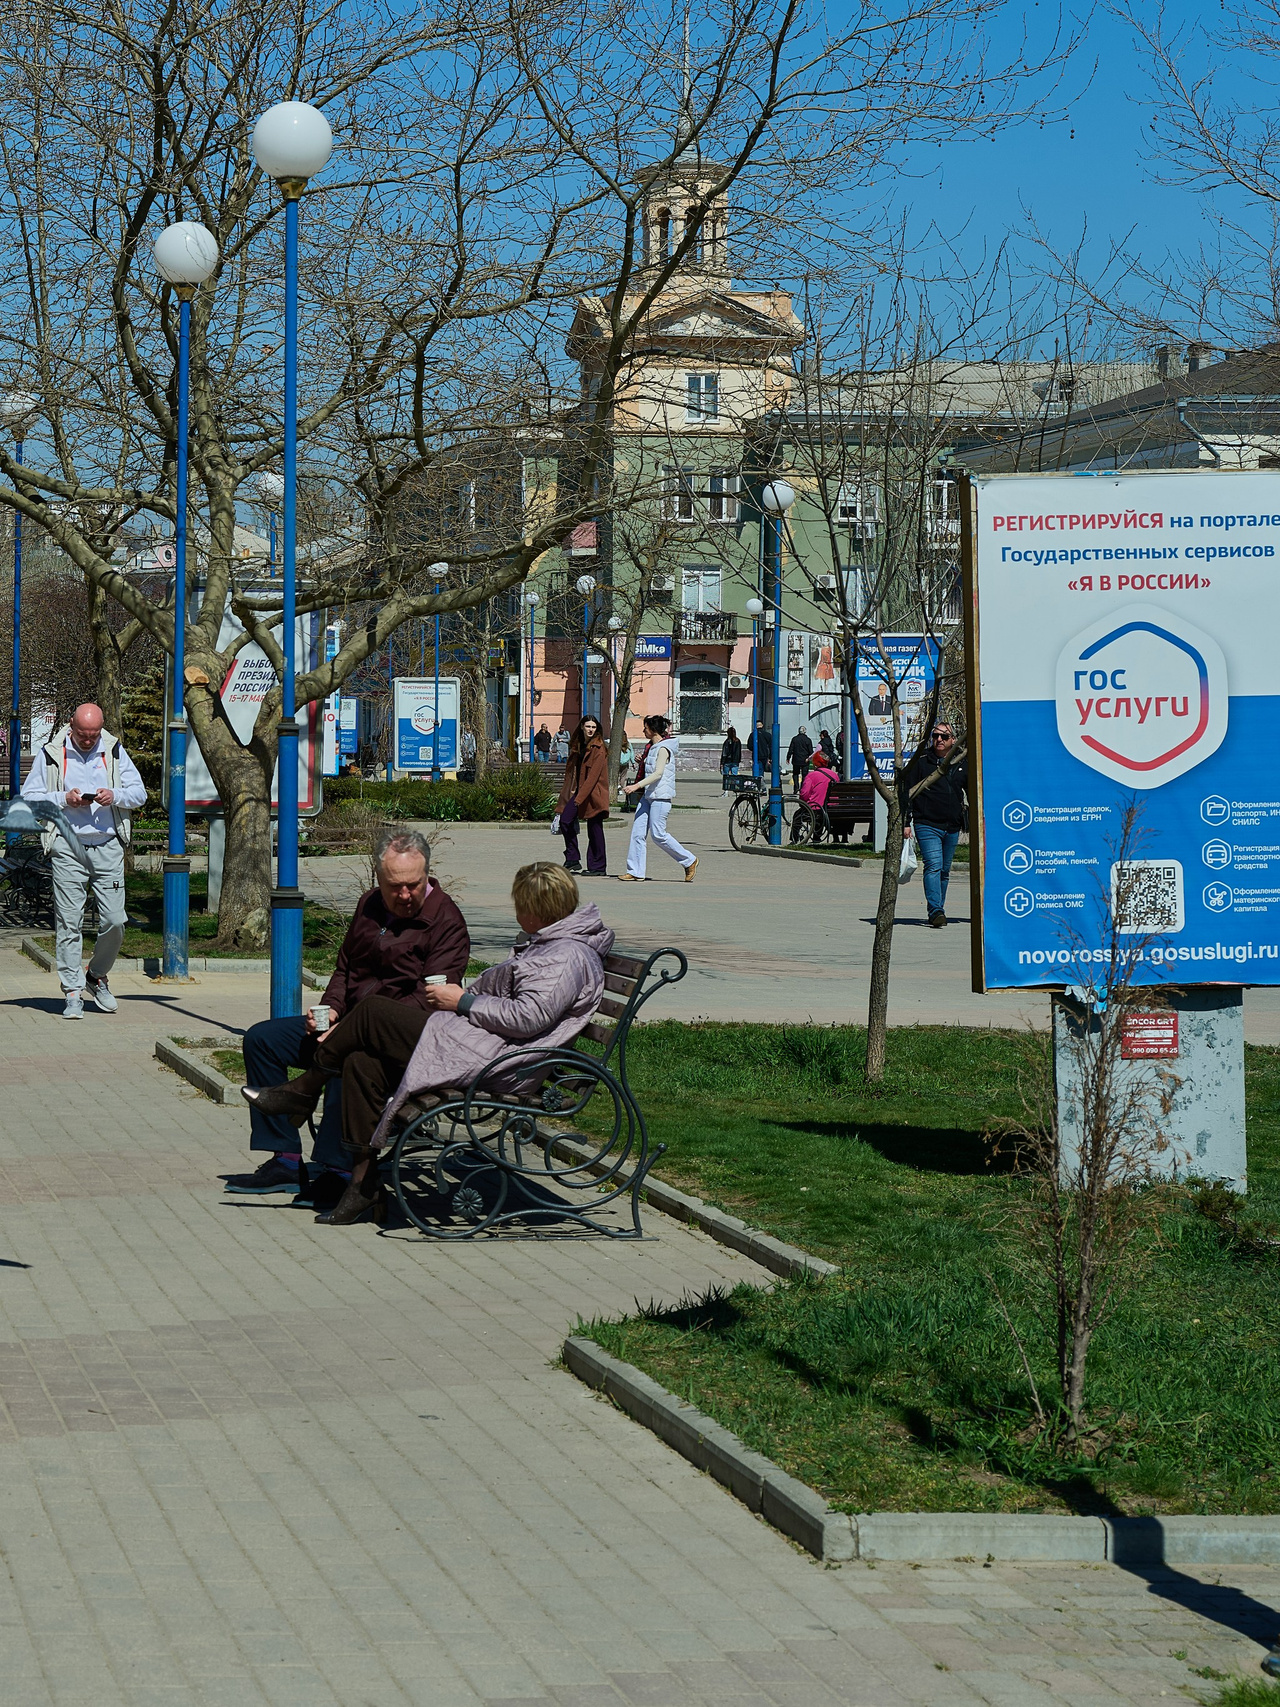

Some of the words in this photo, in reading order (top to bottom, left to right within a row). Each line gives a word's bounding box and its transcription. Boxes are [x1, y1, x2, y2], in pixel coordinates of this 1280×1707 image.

[993, 509, 1163, 531] РЕГИСТРИРУЙСЯ
[1170, 516, 1194, 528] на
[1200, 514, 1280, 531] портале
[1001, 547, 1179, 566] Государственных
[1184, 545, 1275, 562] сервисов
[1068, 575, 1093, 591] «Я
[1099, 575, 1112, 591] В
[1118, 574, 1211, 591] РОССИИ»
[1231, 801, 1280, 809] Оформление
[1033, 806, 1082, 814] Регистрация
[1232, 810, 1269, 818] паспорта,
[1232, 818, 1261, 826] СНИЛС
[1035, 850, 1075, 858] Получение
[1035, 858, 1069, 866] пособий,
[1070, 857, 1100, 865] пенсий,
[1233, 888, 1280, 896] Оформление
[1035, 893, 1086, 901] Оформление
